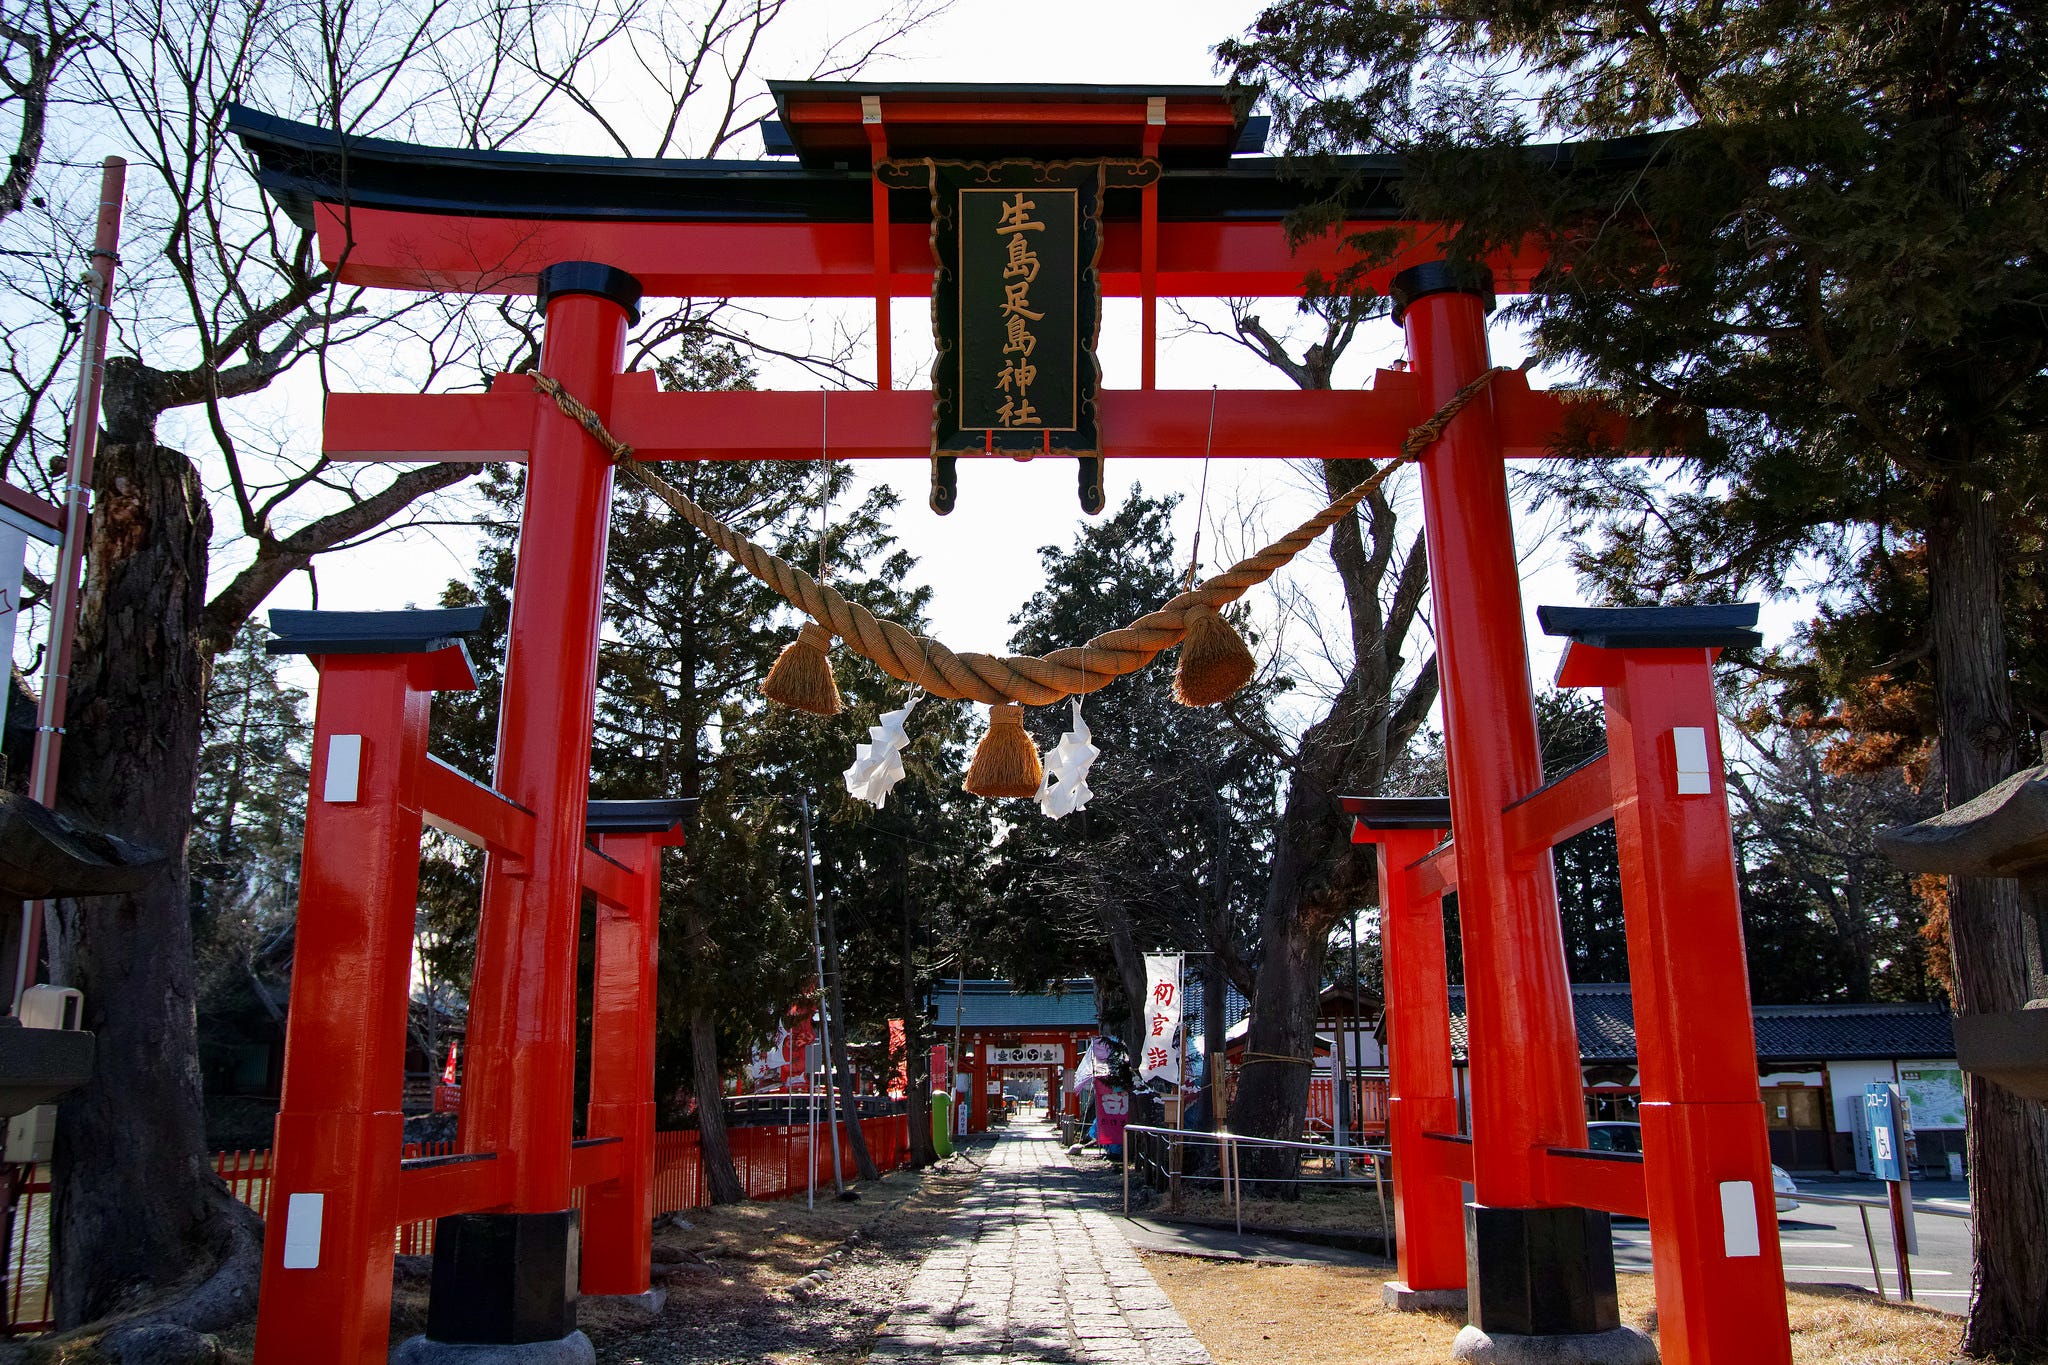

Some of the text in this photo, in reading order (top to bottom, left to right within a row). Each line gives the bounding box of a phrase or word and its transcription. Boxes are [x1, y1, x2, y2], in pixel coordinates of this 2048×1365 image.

[996, 192, 1046, 427] 生島足島神社
[1147, 979, 1175, 1071] 初宮詣
